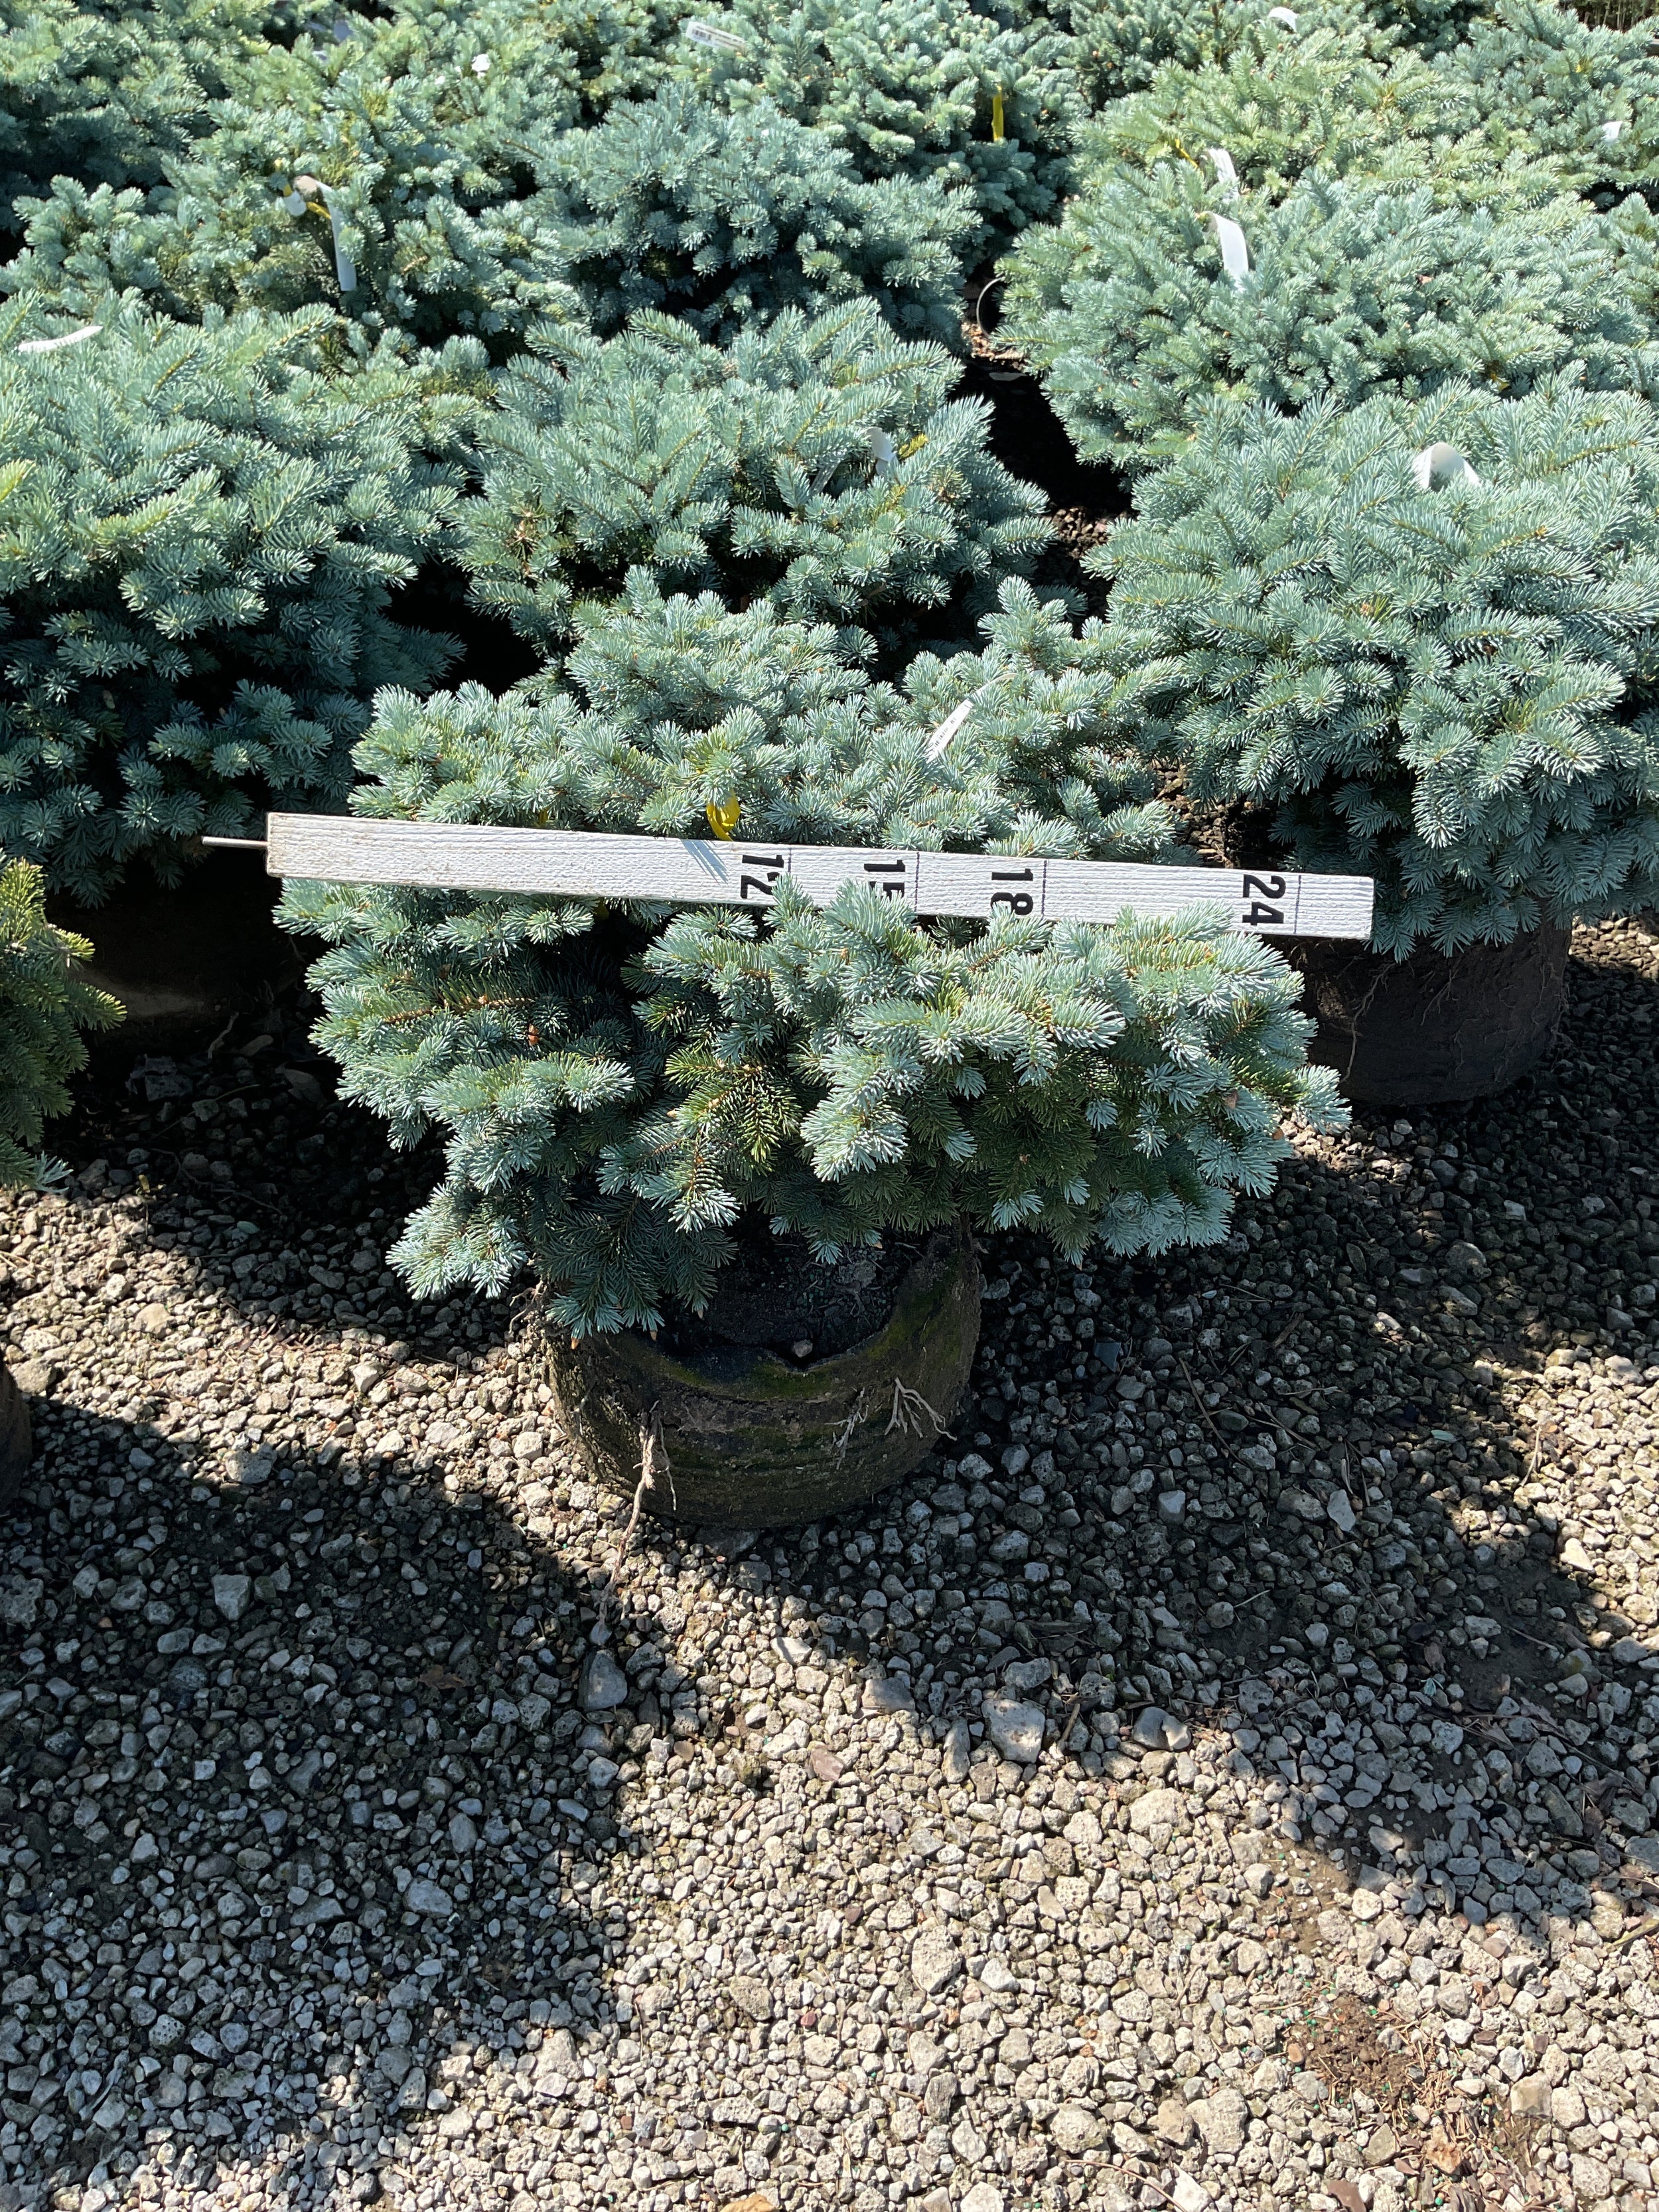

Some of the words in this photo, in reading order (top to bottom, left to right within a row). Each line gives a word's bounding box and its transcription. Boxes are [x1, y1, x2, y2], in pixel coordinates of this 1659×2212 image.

[740, 854, 784, 899] 12
[990, 867, 1034, 916] 18
[1242, 873, 1286, 926] 24
